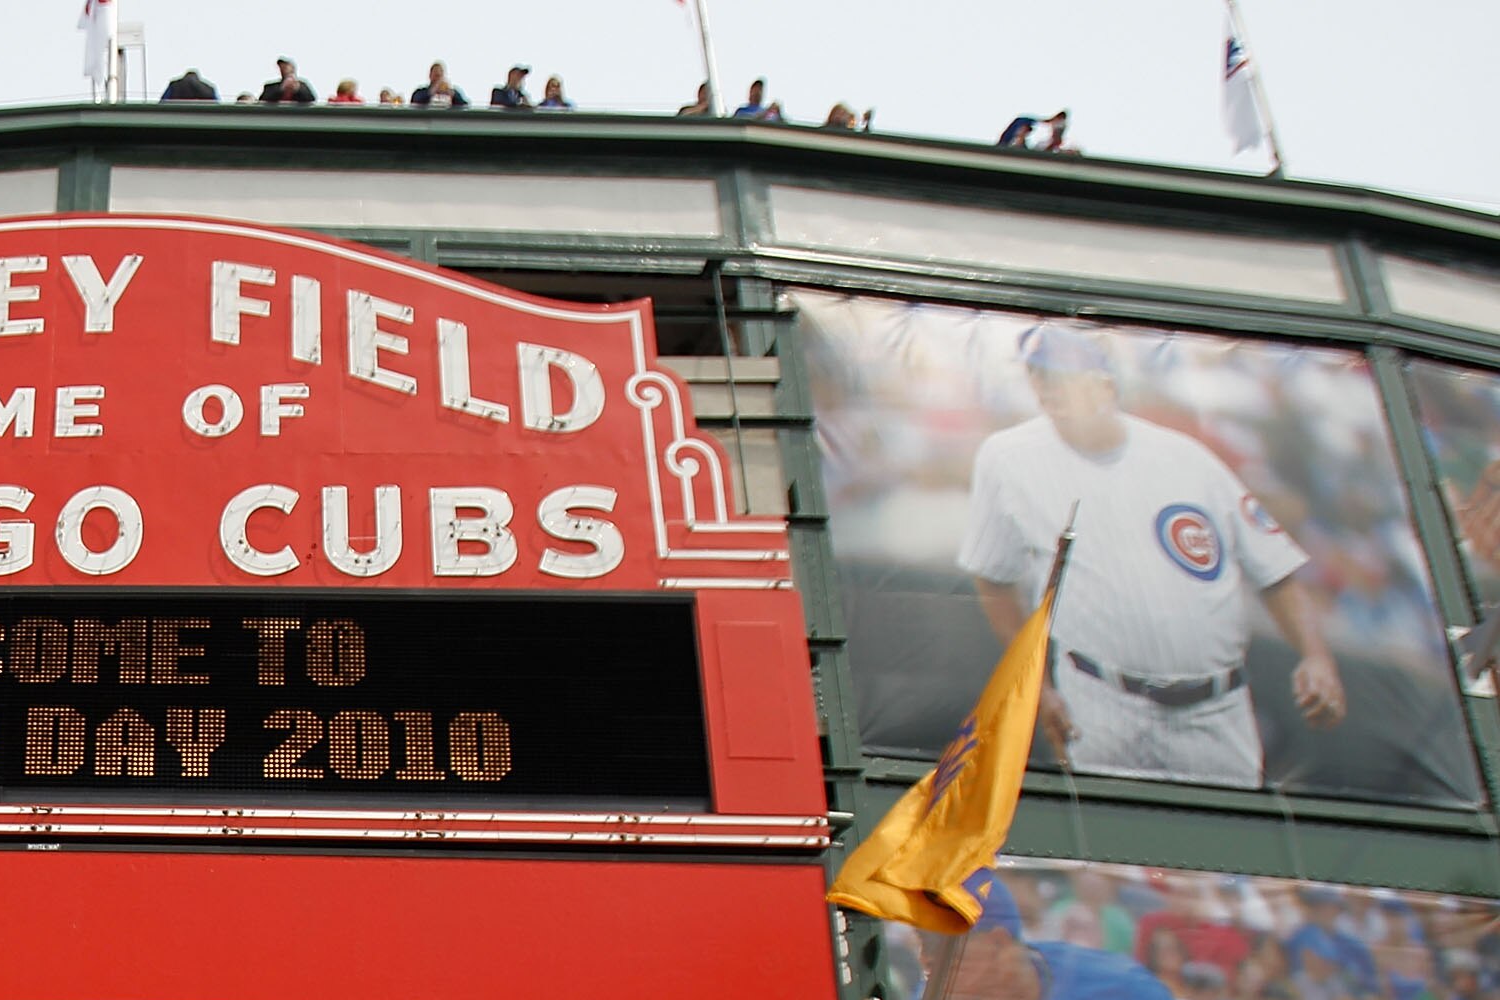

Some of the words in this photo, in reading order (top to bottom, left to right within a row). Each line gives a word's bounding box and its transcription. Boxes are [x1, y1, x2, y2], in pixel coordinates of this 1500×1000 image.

[211, 260, 606, 433] FIELD
[182, 383, 310, 438] OF
[219, 483, 625, 578] CUBS
[242, 617, 366, 686] TO
[24, 705, 226, 777] DAY
[263, 709, 512, 782] 2010
